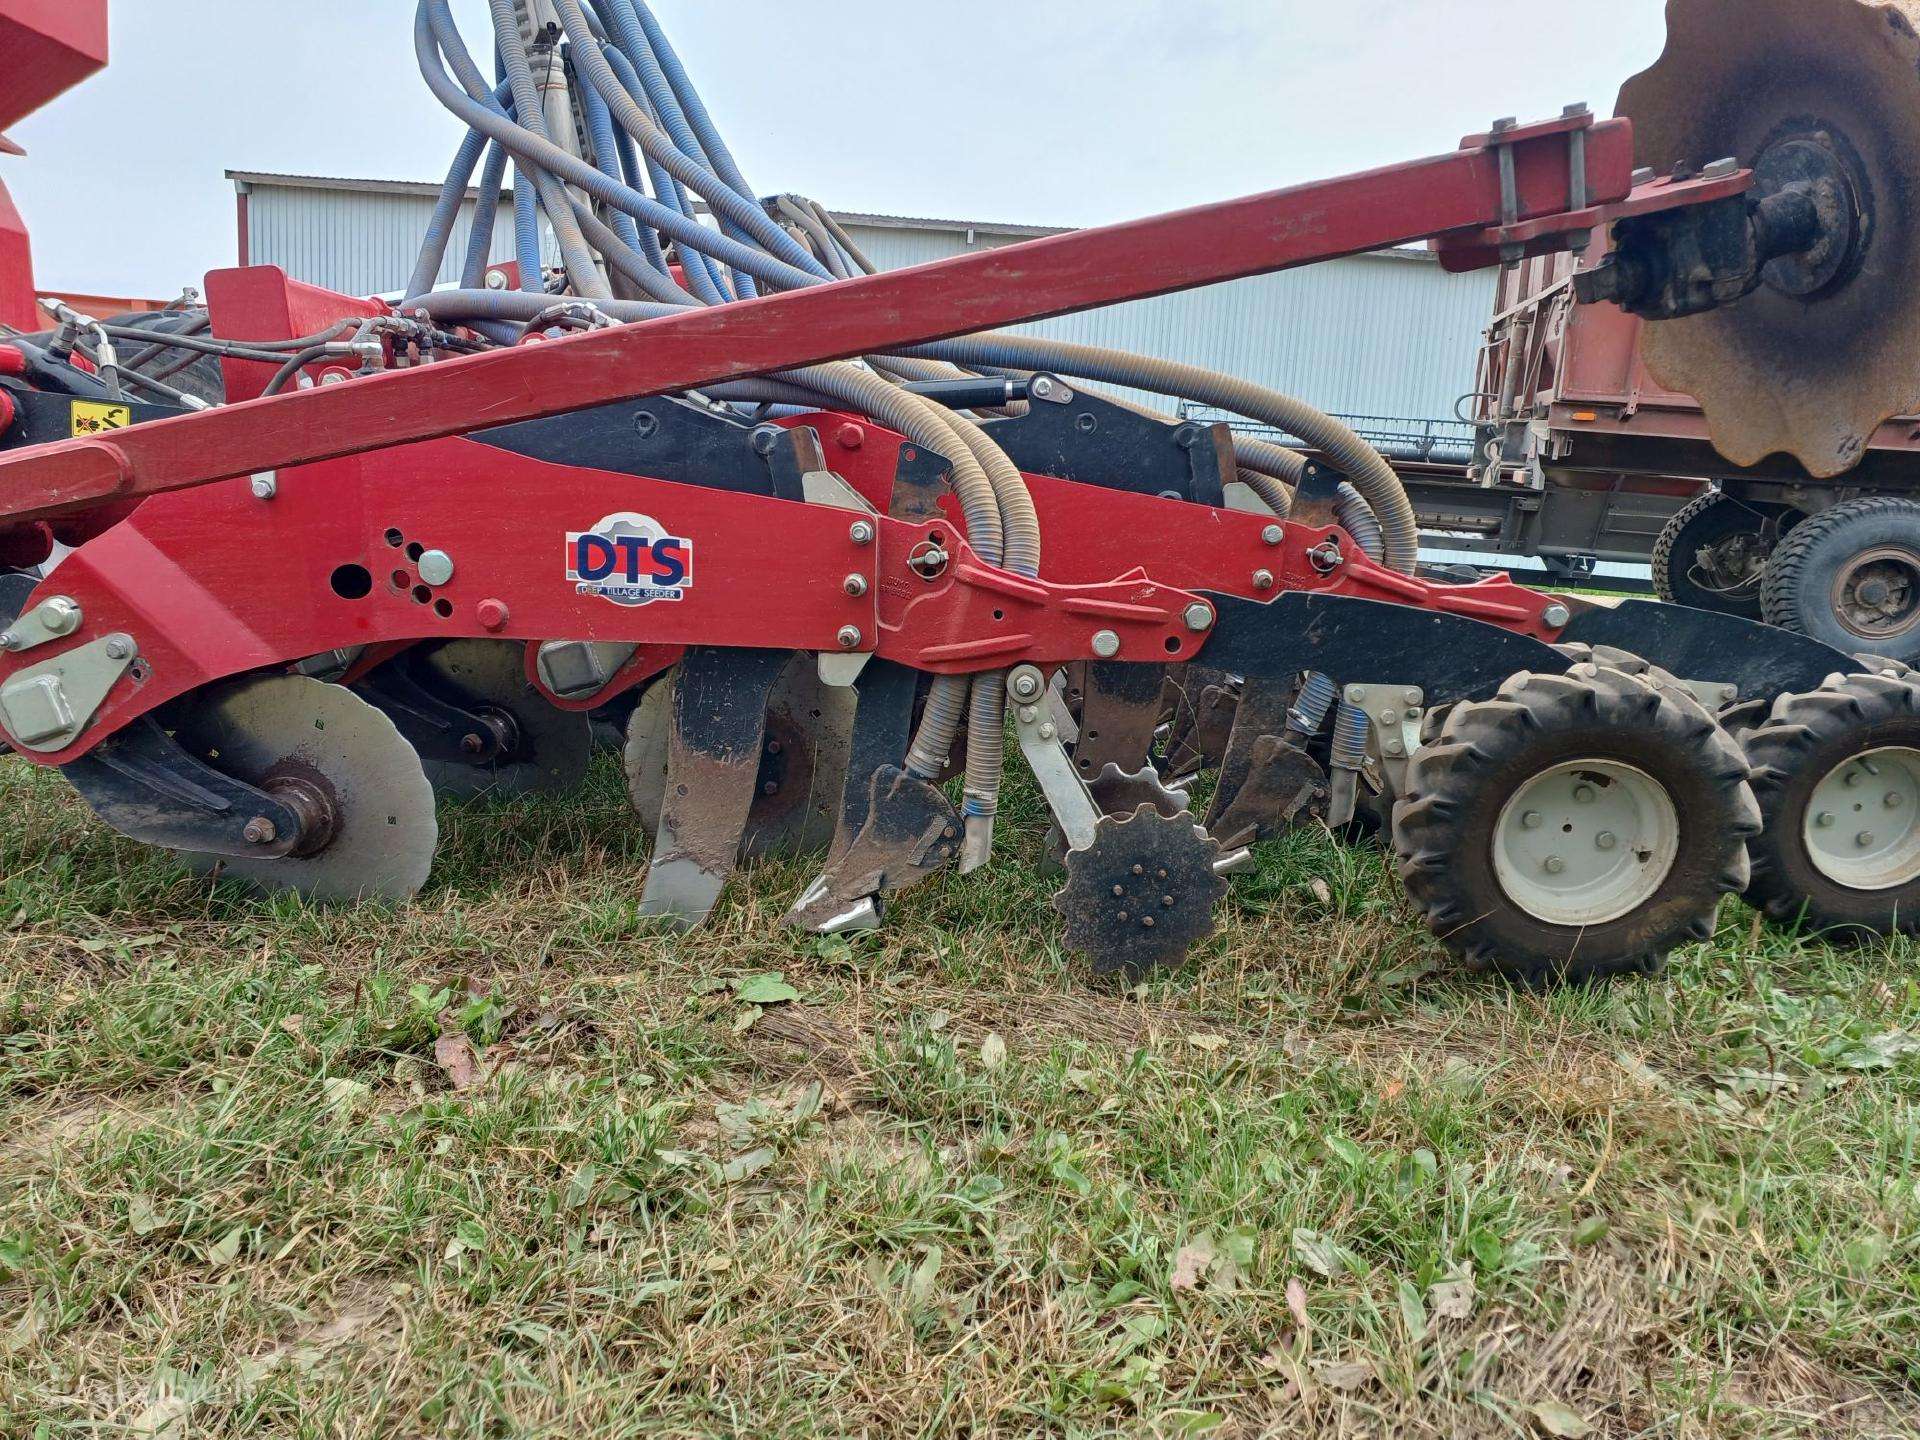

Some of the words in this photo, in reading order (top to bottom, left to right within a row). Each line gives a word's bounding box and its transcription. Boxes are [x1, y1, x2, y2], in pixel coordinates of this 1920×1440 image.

[577, 534, 684, 586] DTS
[607, 587, 640, 597] TILLAGE
[644, 589, 676, 599] SEEDER
